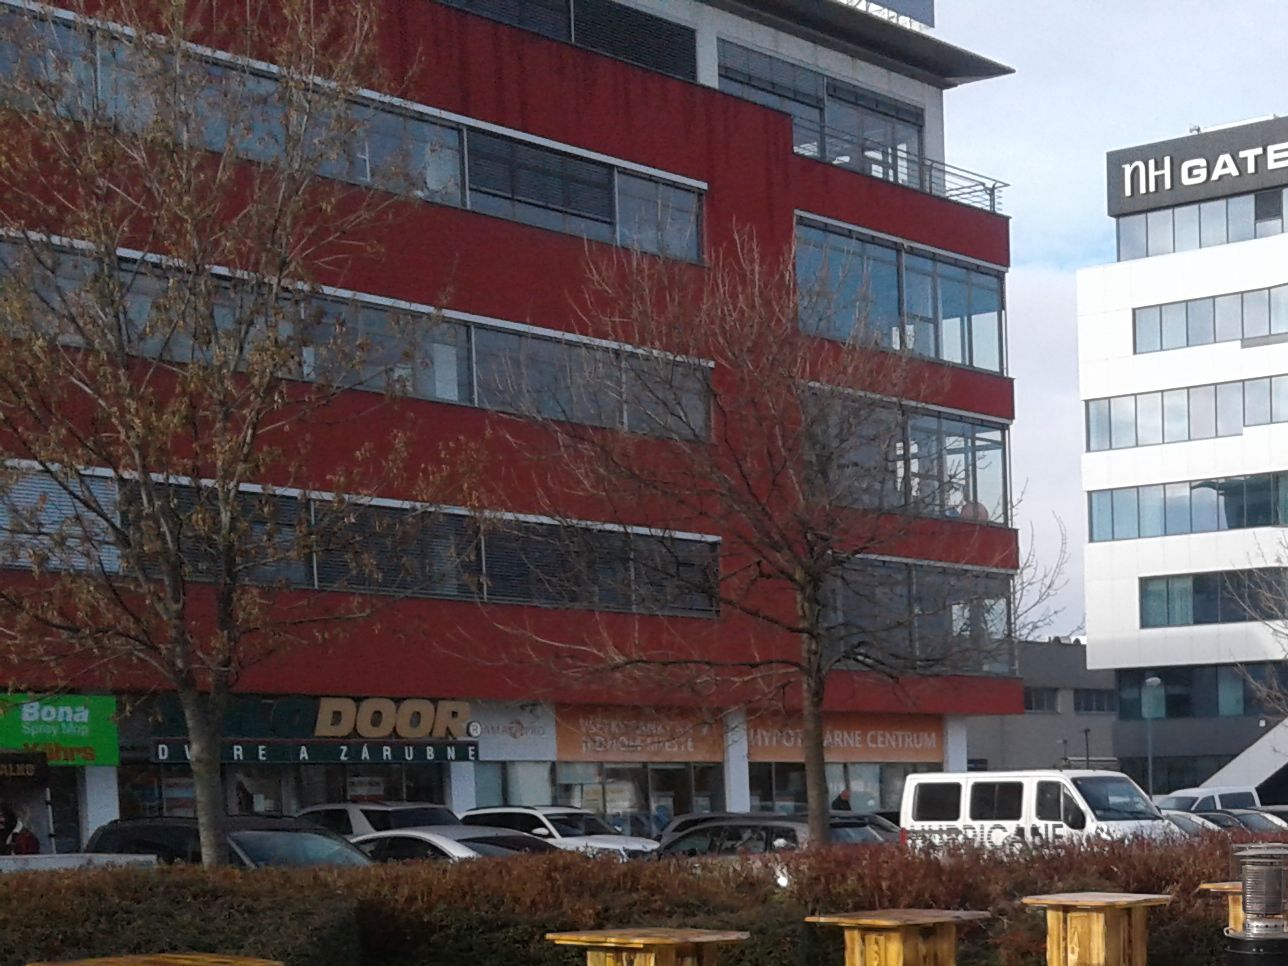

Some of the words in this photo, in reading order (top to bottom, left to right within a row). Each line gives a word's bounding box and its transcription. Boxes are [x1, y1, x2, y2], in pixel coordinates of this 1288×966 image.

[22, 701, 88, 722] Bona
[867, 730, 937, 749] CENTRUM
[158, 744, 267, 760] DVRE
[299, 746, 309, 761] A
[339, 743, 477, 761] ZÁRUBNE
